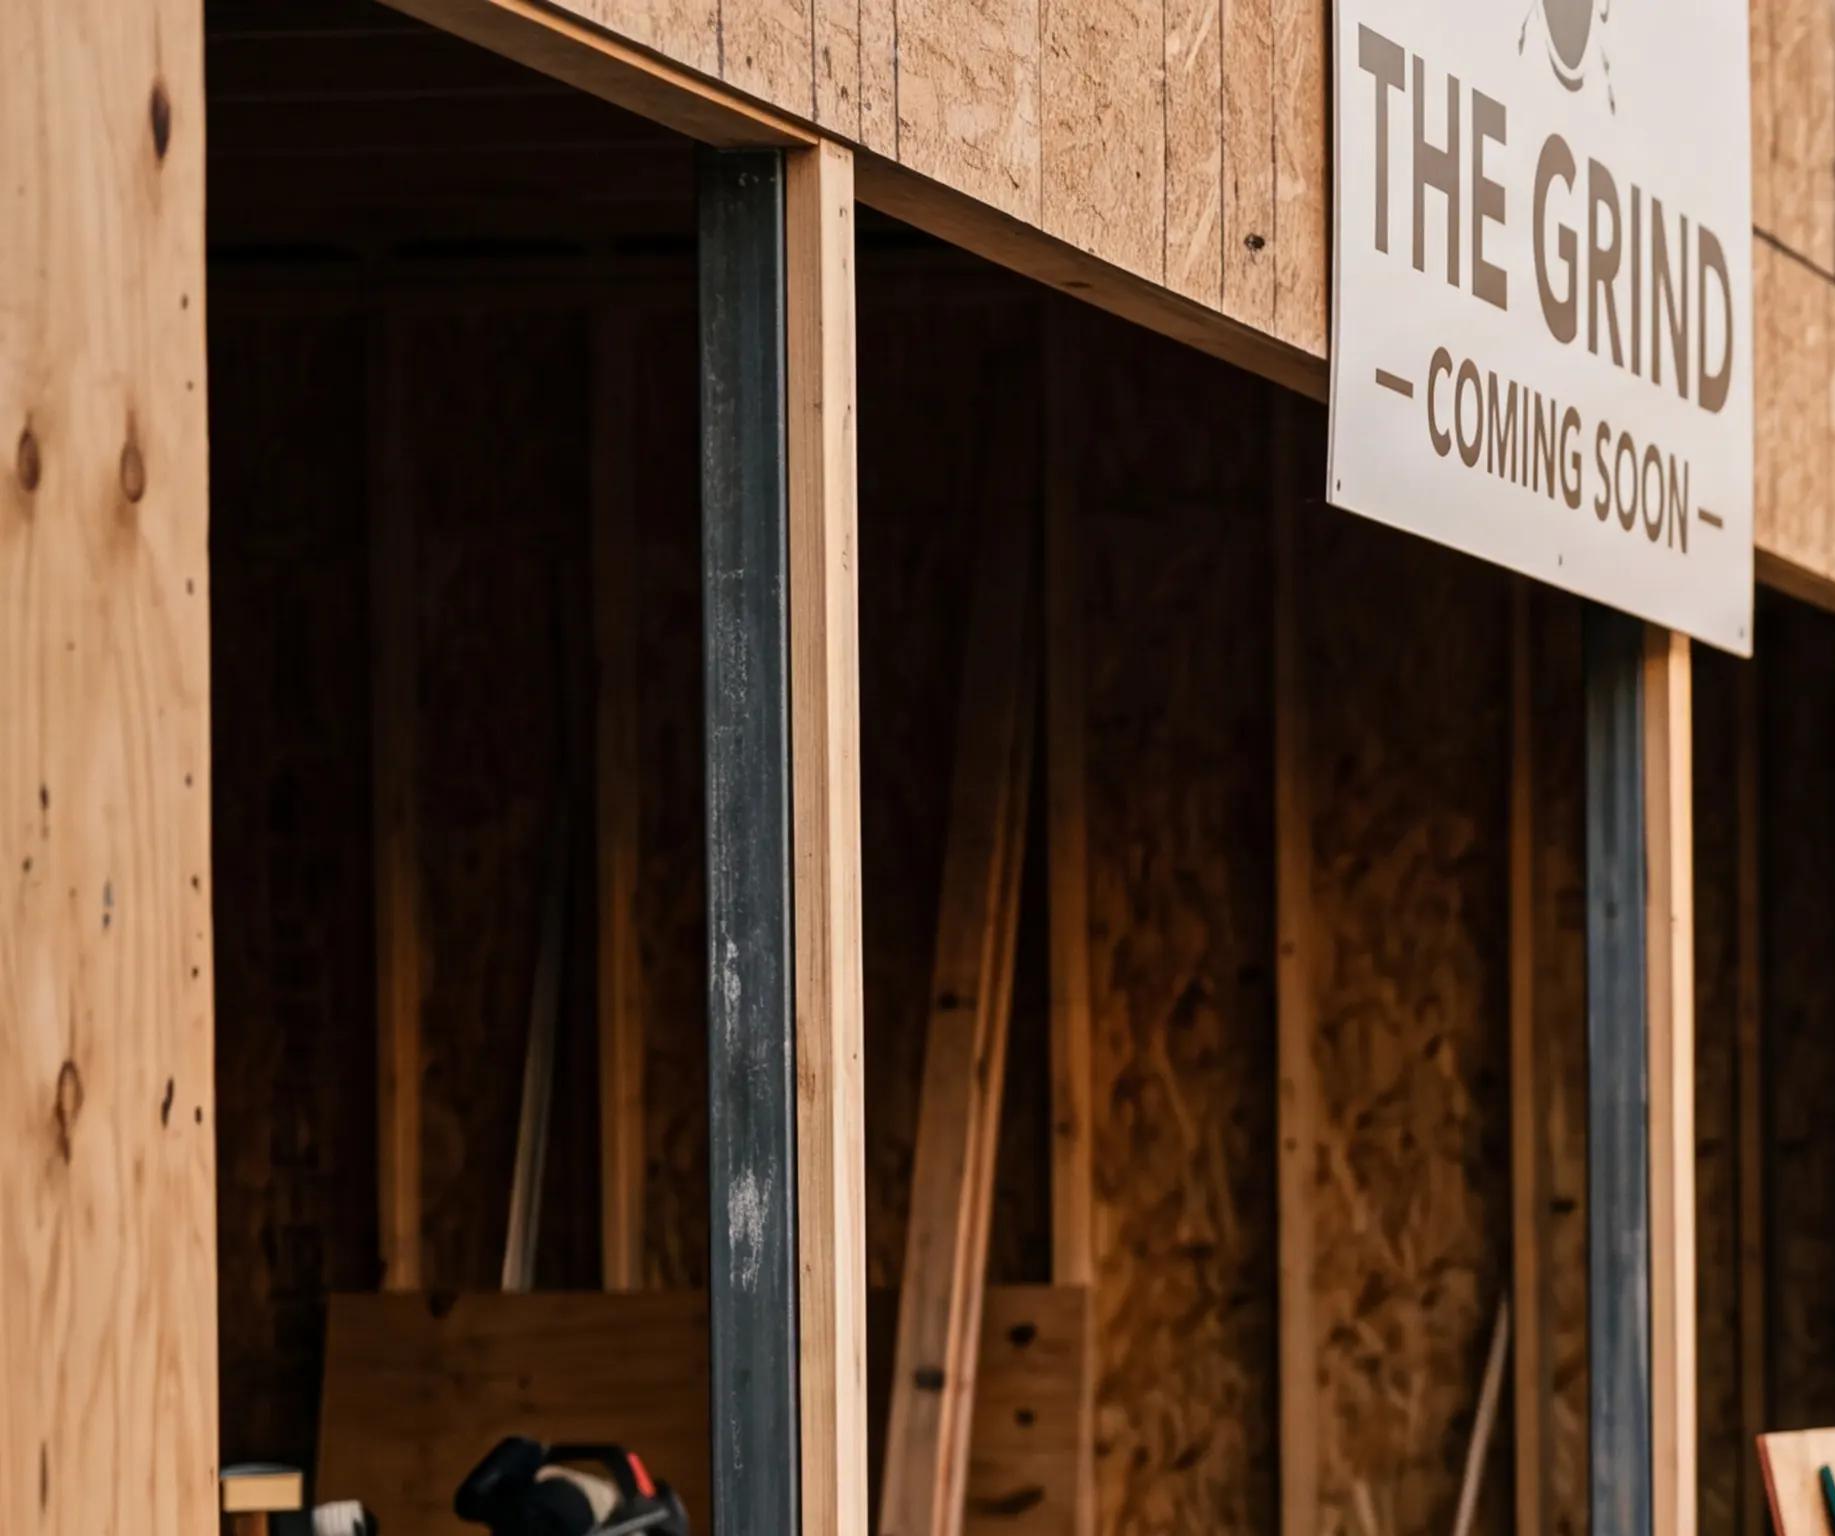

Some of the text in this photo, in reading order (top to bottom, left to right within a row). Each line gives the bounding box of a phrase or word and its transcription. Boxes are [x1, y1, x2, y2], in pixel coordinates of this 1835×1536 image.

[1357, 21, 1734, 415] THE GRIND
[1426, 346, 1690, 555] COMING SOON
